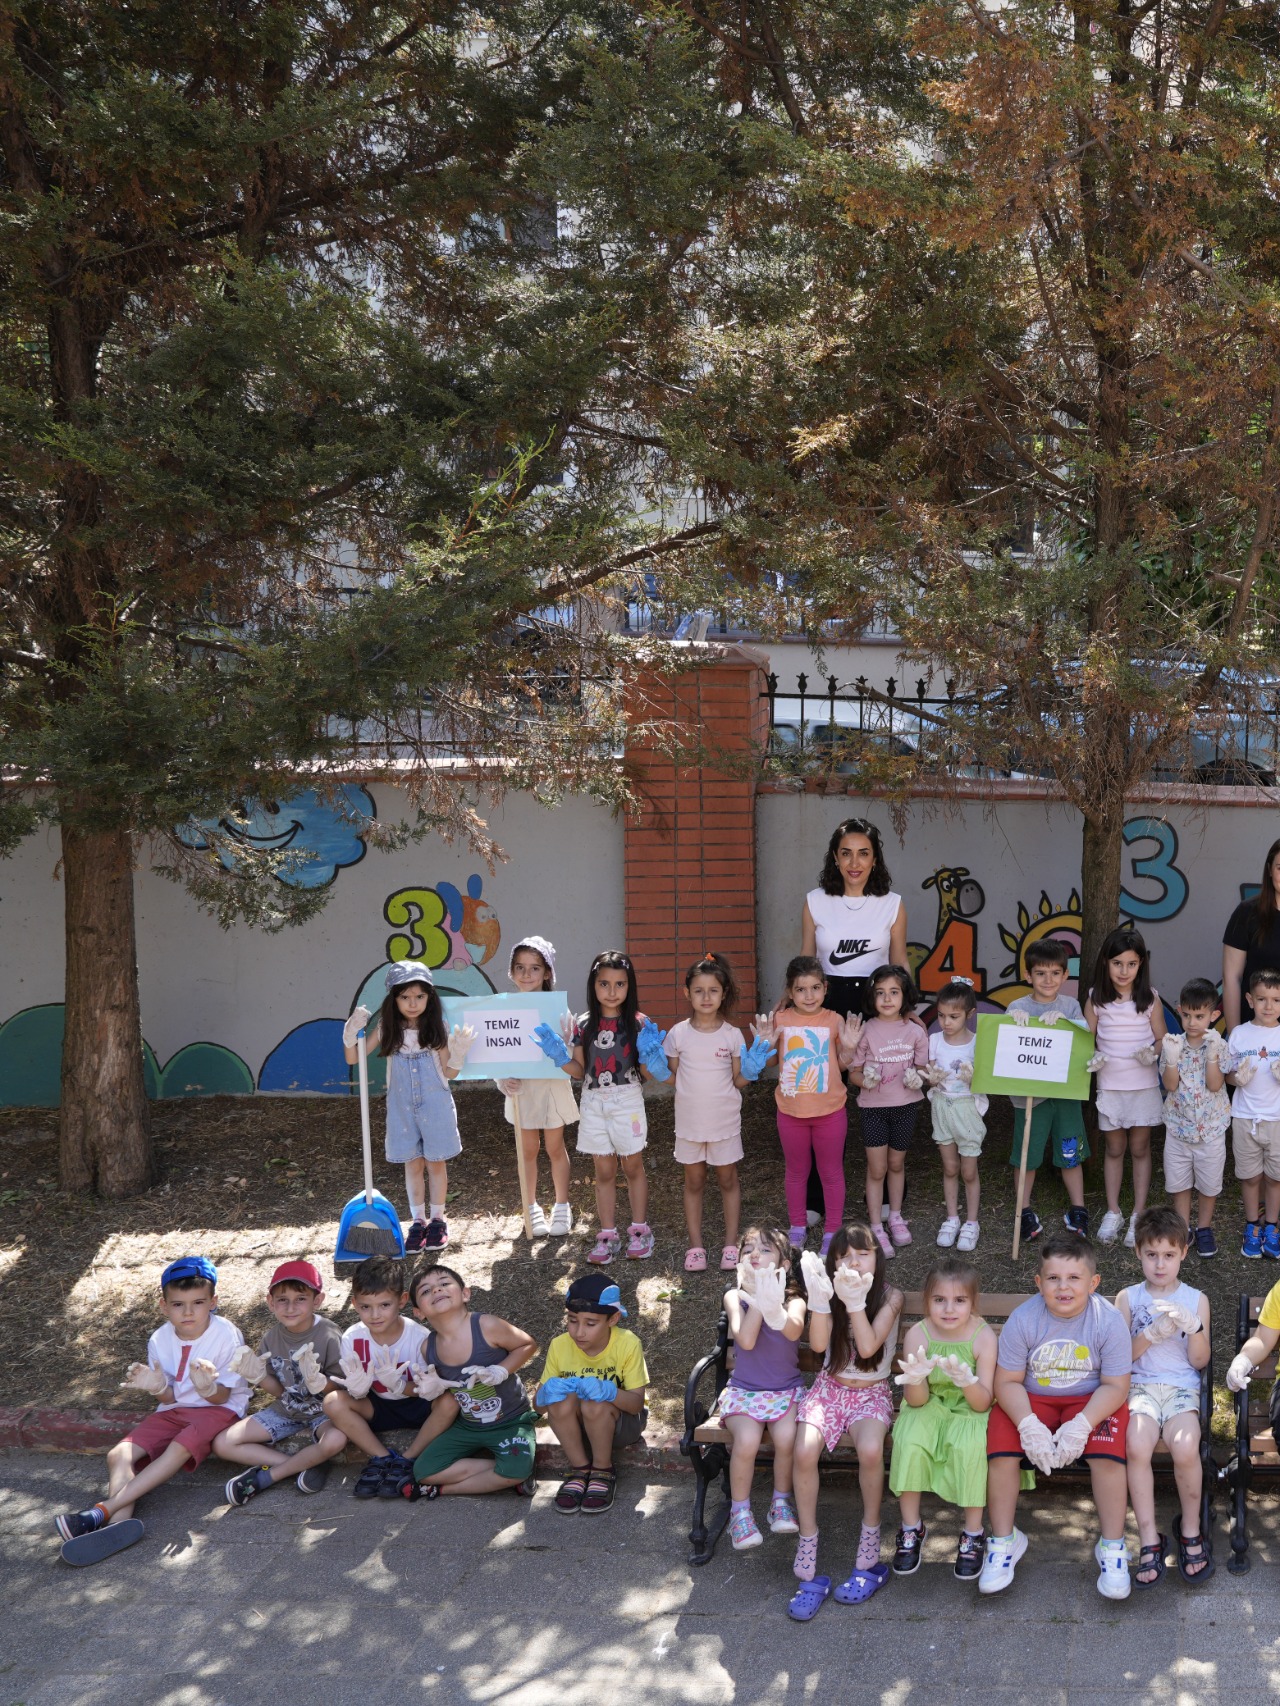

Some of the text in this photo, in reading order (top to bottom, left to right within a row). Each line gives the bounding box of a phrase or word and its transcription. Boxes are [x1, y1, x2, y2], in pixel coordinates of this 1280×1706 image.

[383, 886, 452, 970] 3
[836, 939, 871, 953] NIKE
[485, 1018, 520, 1030] TEMİZ
[486, 1036, 522, 1047] İNSAN
[1018, 1036, 1053, 1048] TEMİZ
[1017, 1054, 1048, 1065] OKUL
[1038, 1342, 1076, 1361] PLAY
[512, 1437, 530, 1445] POLO
